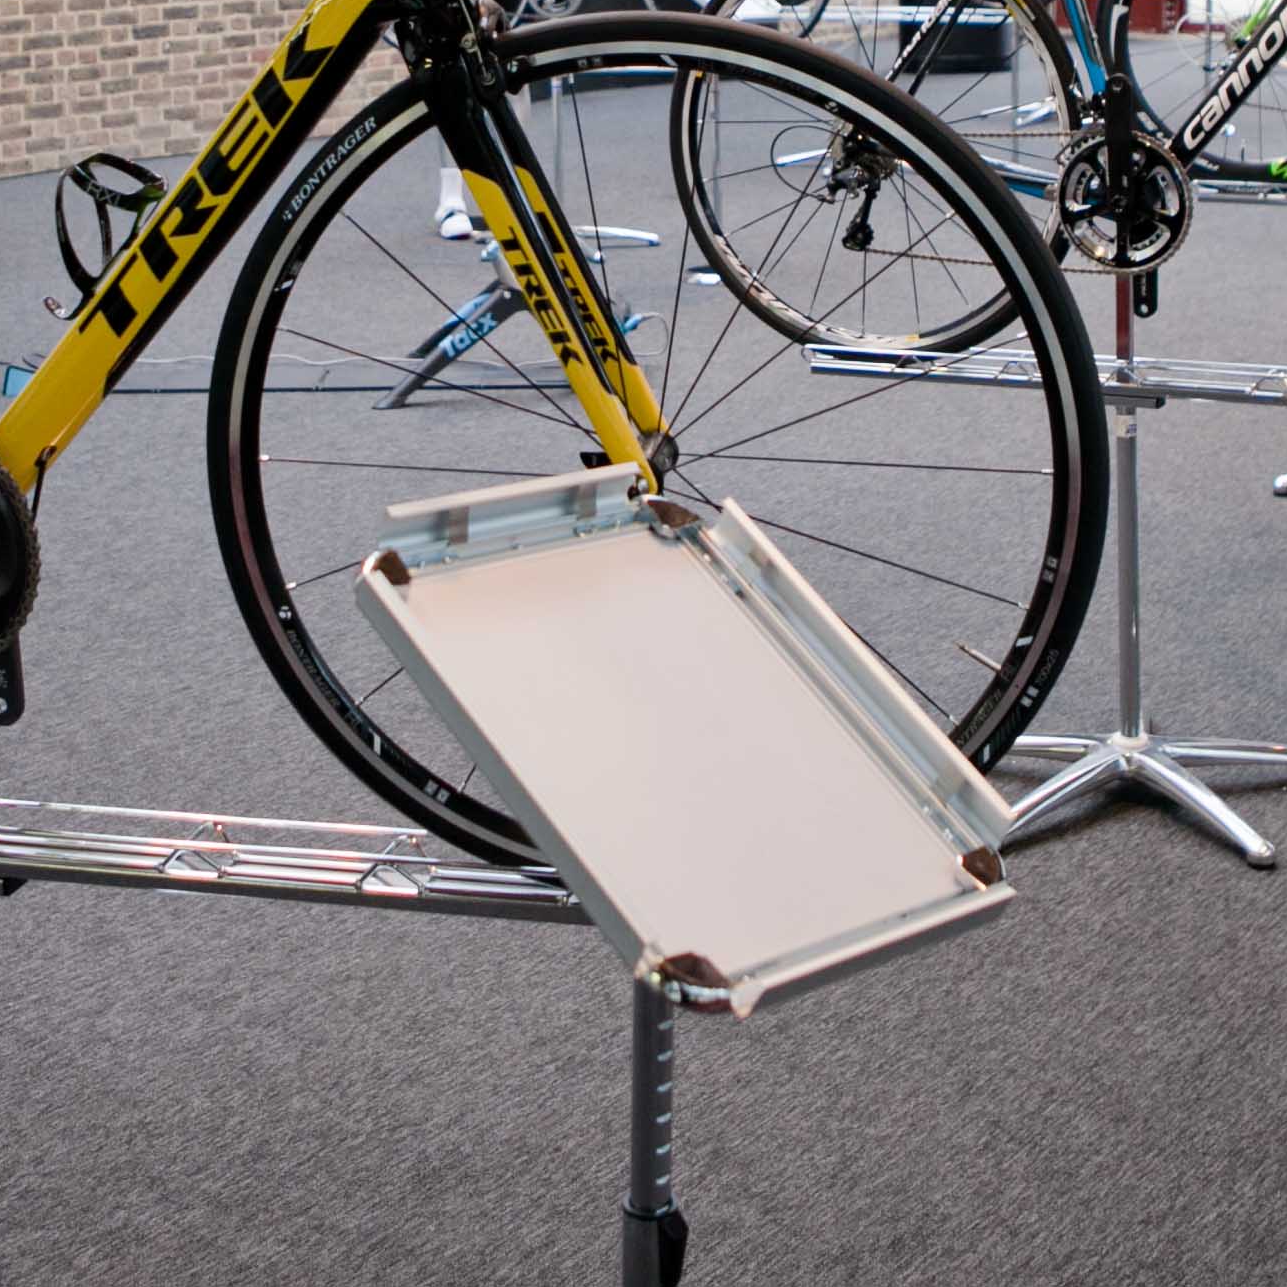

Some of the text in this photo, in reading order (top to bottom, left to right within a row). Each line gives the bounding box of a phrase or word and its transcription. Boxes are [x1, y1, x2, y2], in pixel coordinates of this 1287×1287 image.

[78, 19, 335, 340] TREK
[290, 116, 378, 211] BONTRAGER
[500, 225, 585, 367] TREK
